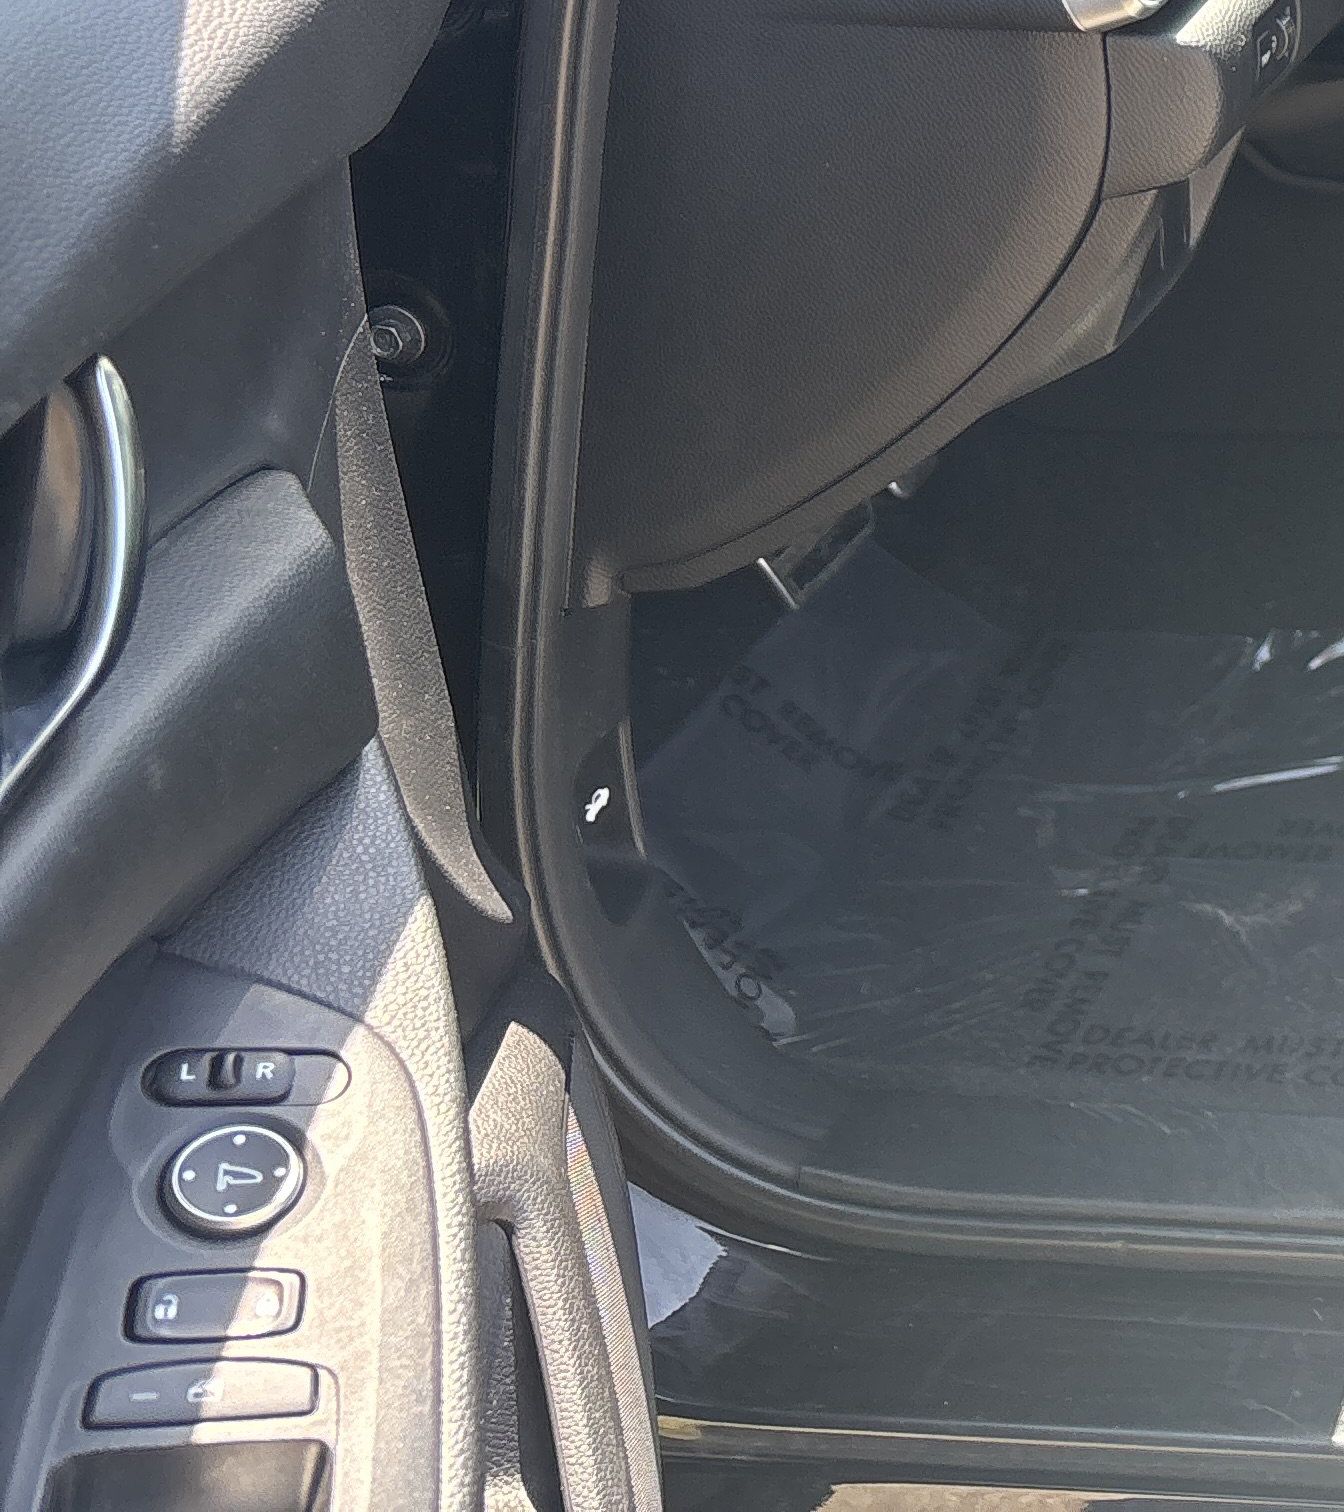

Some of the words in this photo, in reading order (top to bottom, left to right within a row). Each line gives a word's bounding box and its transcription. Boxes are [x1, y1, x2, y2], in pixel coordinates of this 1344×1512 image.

[1081, 1024, 1218, 1052] DEALER
[180, 1063, 196, 1080] L
[256, 1062, 275, 1080] R
[1065, 1051, 1289, 1085] PROTECTIVE
